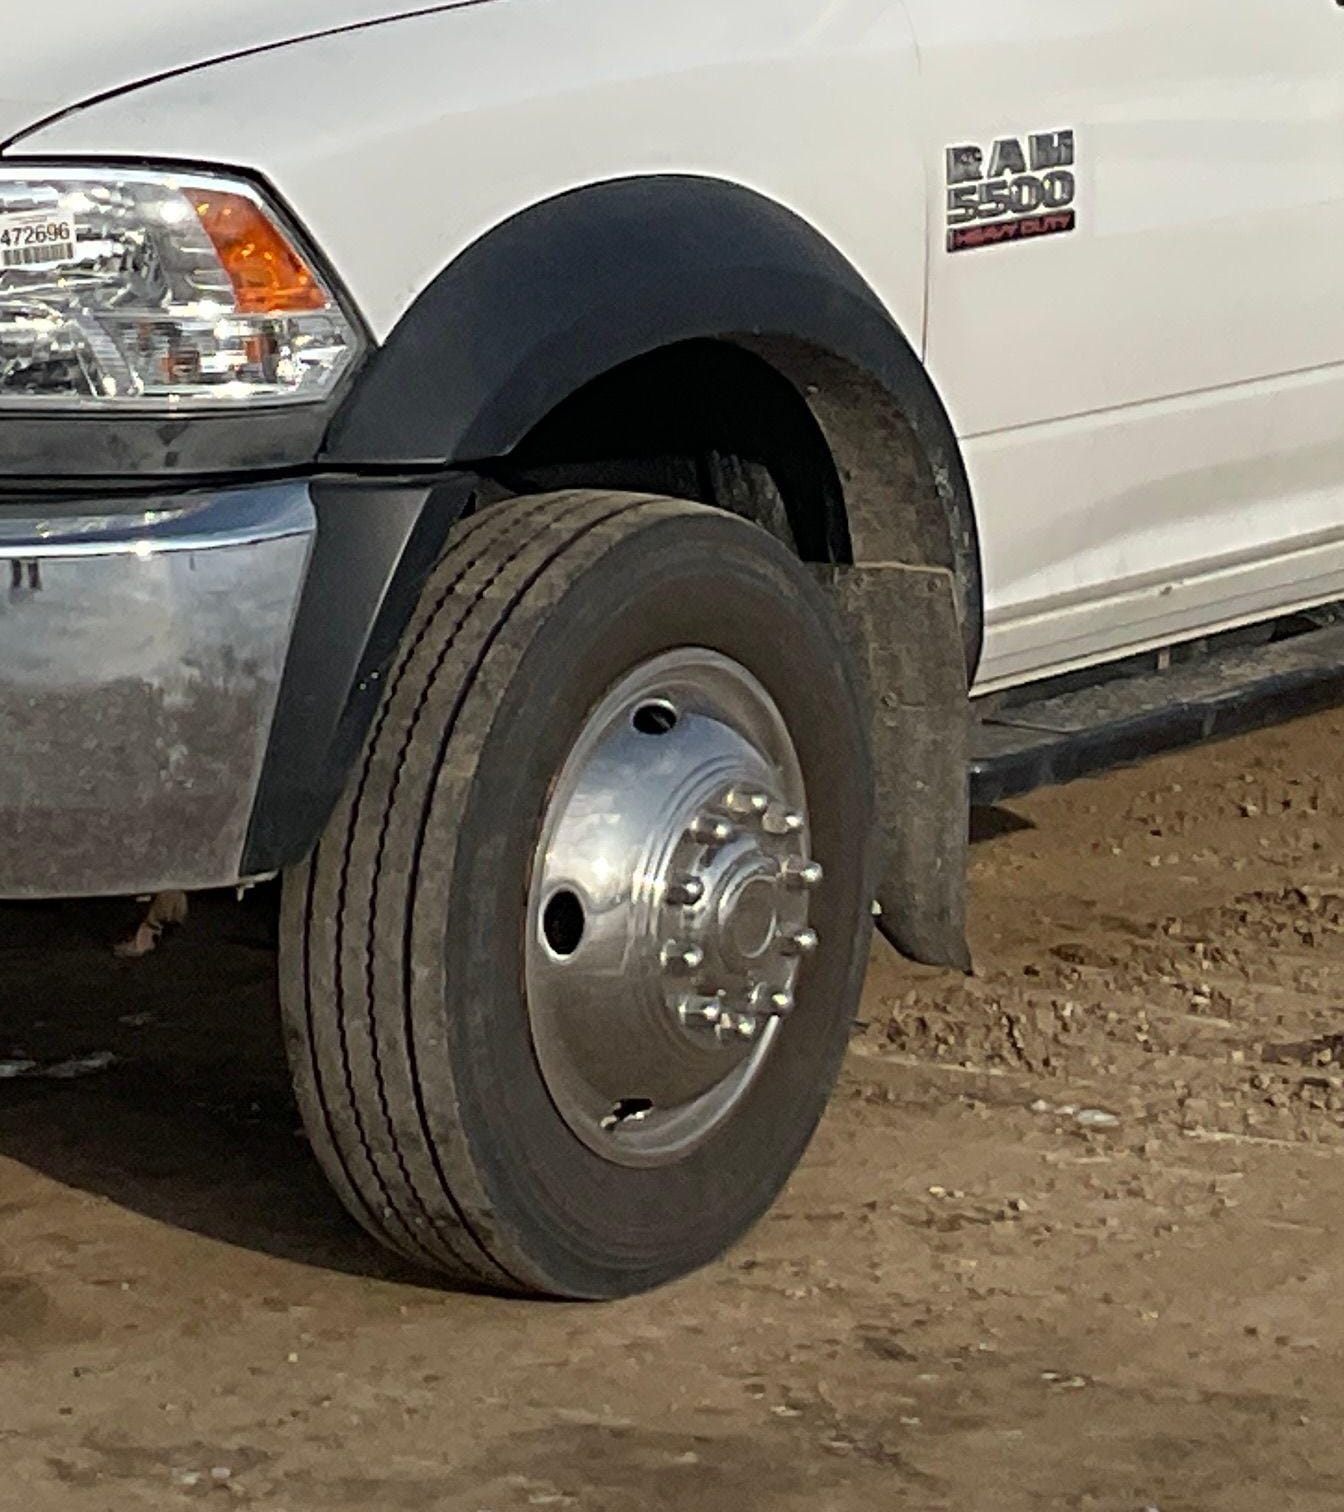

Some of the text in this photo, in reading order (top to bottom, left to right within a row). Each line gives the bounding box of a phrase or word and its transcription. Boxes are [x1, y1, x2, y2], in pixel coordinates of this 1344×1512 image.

[946, 129, 1074, 185] RAM
[947, 170, 1076, 225] 5500
[0, 223, 70, 246] 472696
